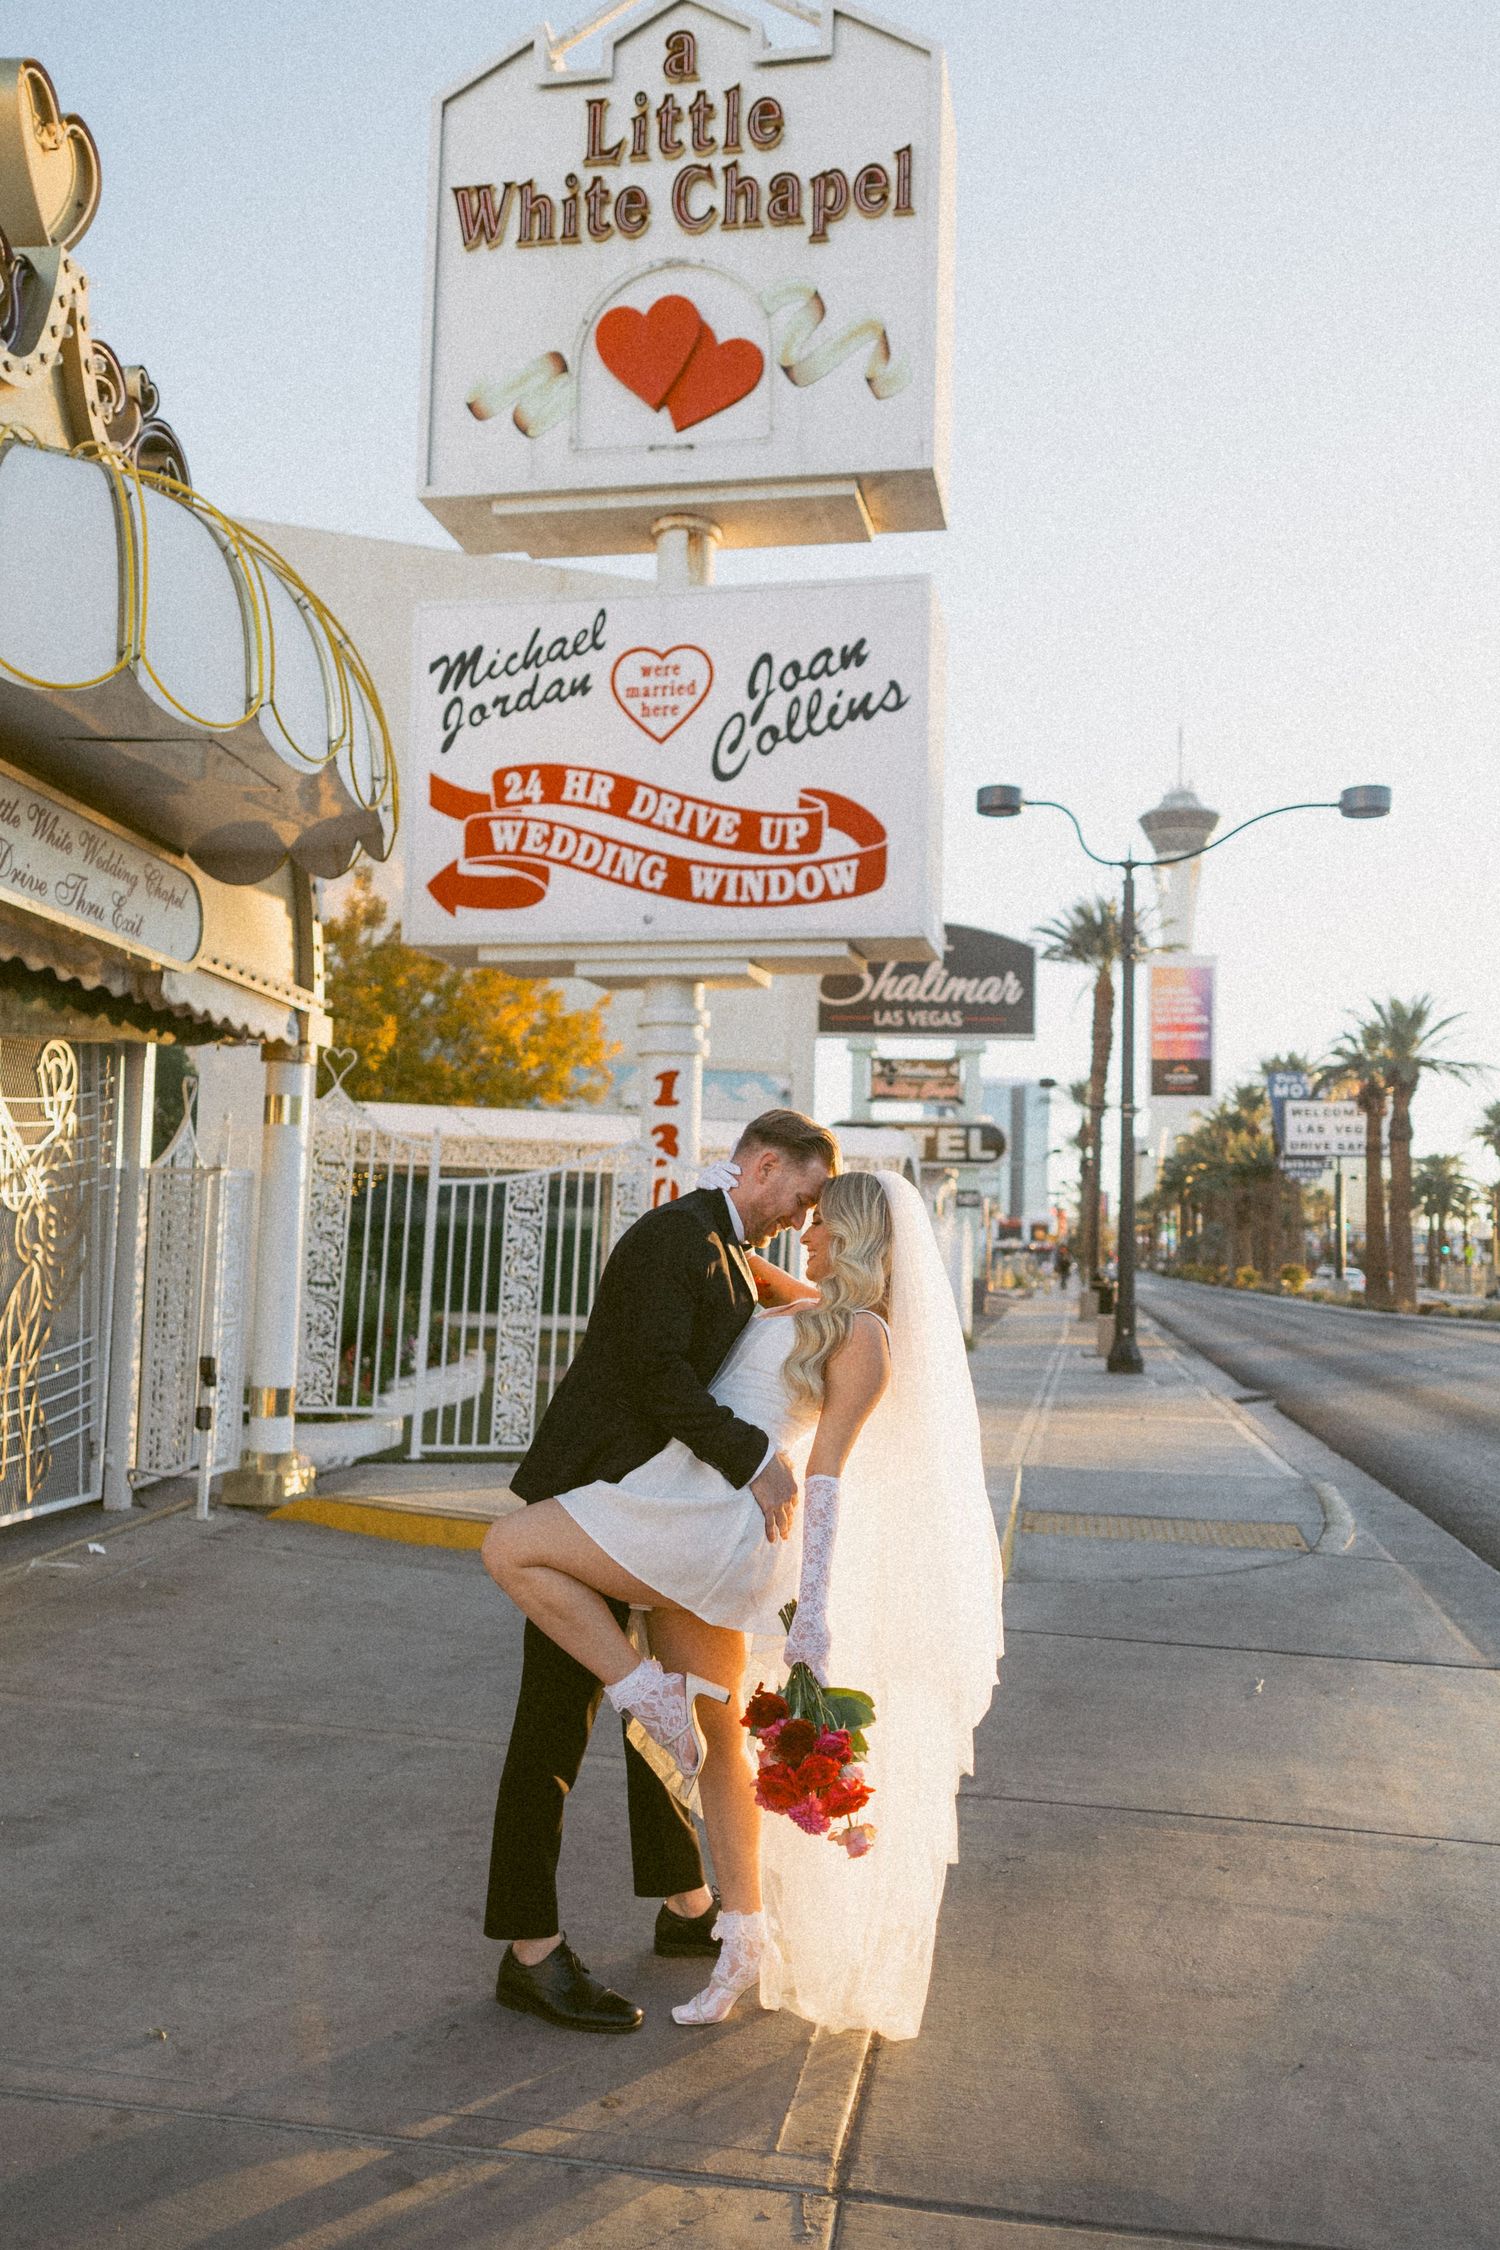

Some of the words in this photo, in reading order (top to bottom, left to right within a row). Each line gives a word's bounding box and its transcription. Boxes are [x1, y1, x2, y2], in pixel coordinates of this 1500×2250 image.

[663, 30, 699, 83] a
[584, 83, 784, 167] Little
[452, 172, 649, 251] White
[672, 144, 915, 243] Chapel
[429, 608, 607, 695] Michael
[626, 679, 696, 699] married
[641, 662, 680, 678] were
[747, 637, 870, 725] Joan
[441, 669, 593, 753] Jordan
[641, 701, 679, 718] here
[711, 679, 911, 781] Collins
[504, 770, 544, 804] 24
[561, 770, 614, 809] HR
[630, 786, 740, 845] DRIVE
[760, 817, 810, 851] UP
[27, 803, 73, 855] White
[78, 831, 138, 897] Wedding
[144, 863, 188, 911] Chapel
[489, 820, 668, 890] WEDDING
[690, 860, 860, 904] WINDOW
[55, 873, 105, 921] Thru
[112, 890, 144, 937] Exit
[873, 1009, 904, 1026] LAS
[906, 1010, 964, 1027] VEGAS
[910, 1127, 998, 1161] TEL
[1335, 1124, 1364, 1133] VEG
